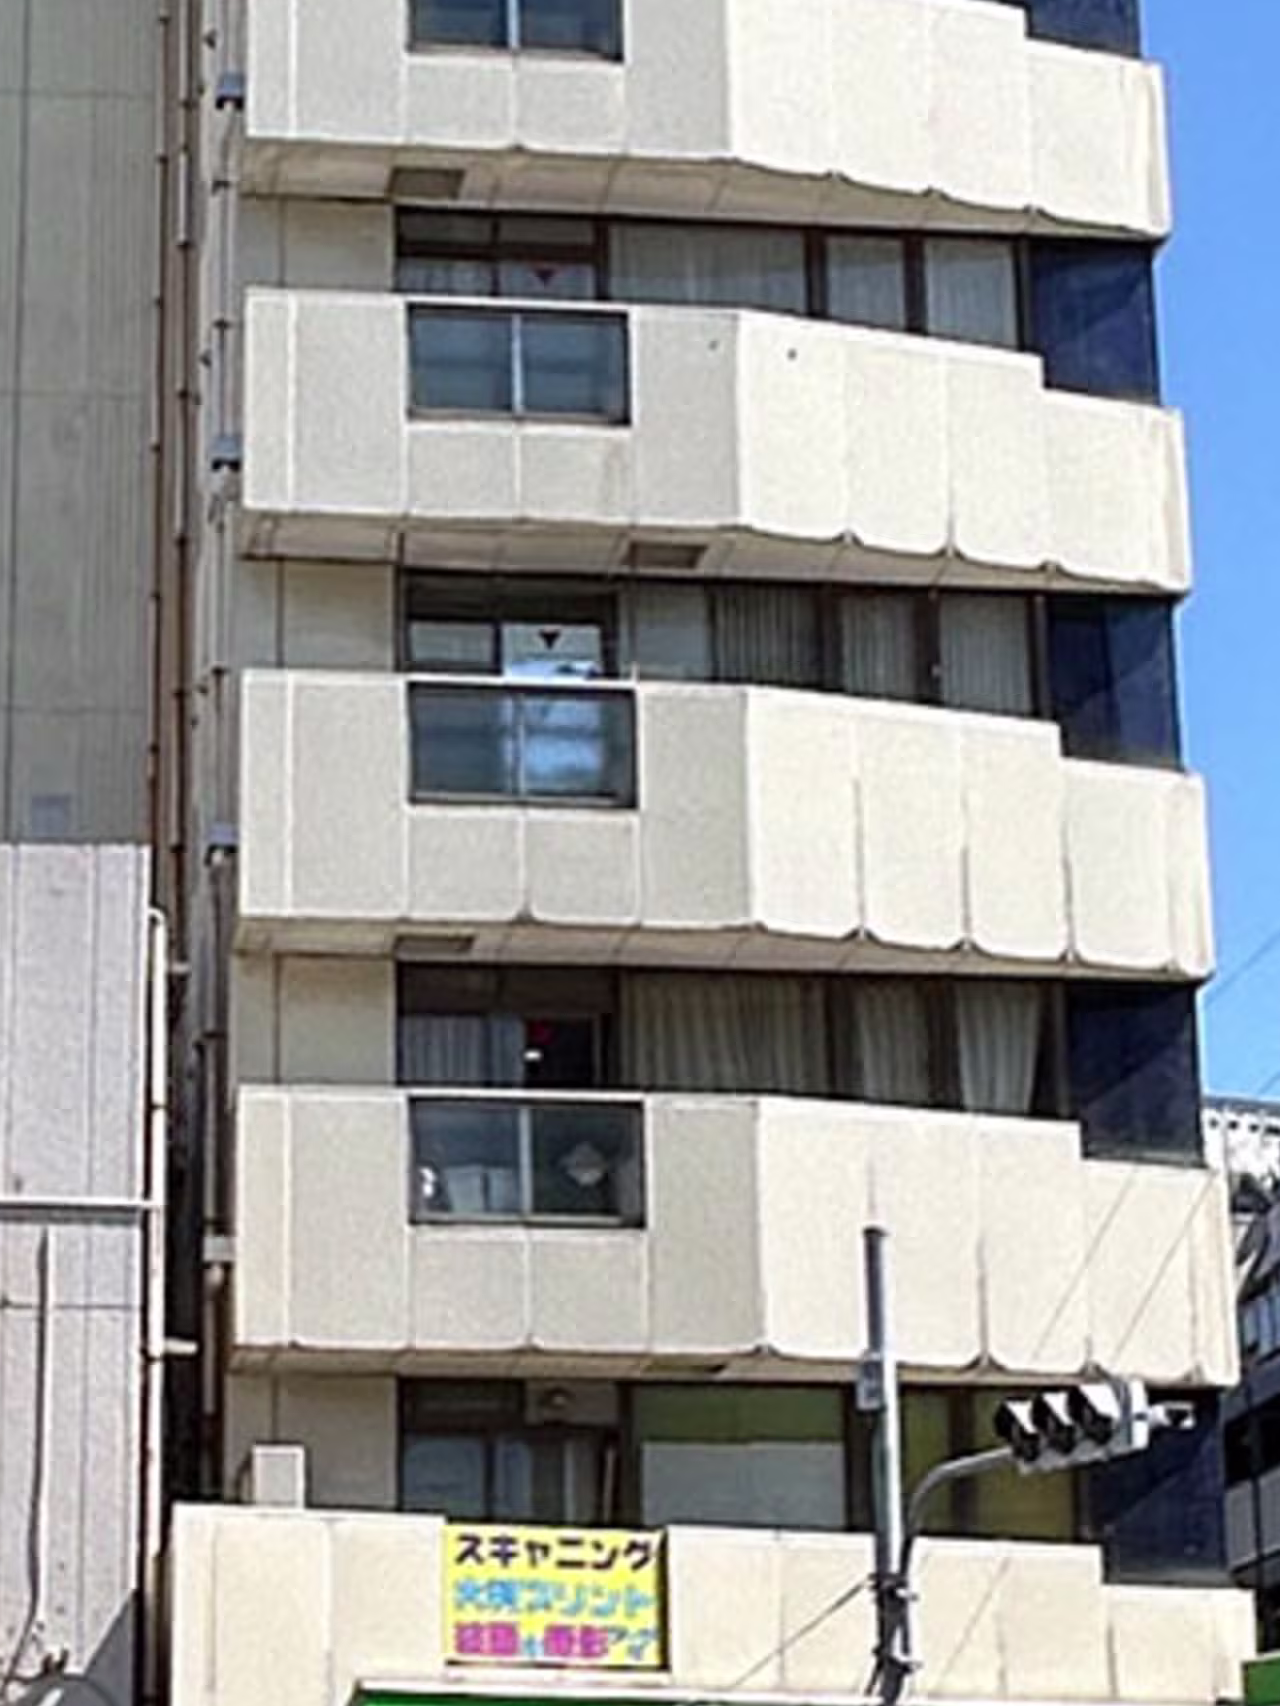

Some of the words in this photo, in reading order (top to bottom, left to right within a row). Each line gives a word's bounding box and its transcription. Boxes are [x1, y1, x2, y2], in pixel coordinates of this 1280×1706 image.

[455, 1533, 653, 1572] スキャニング
